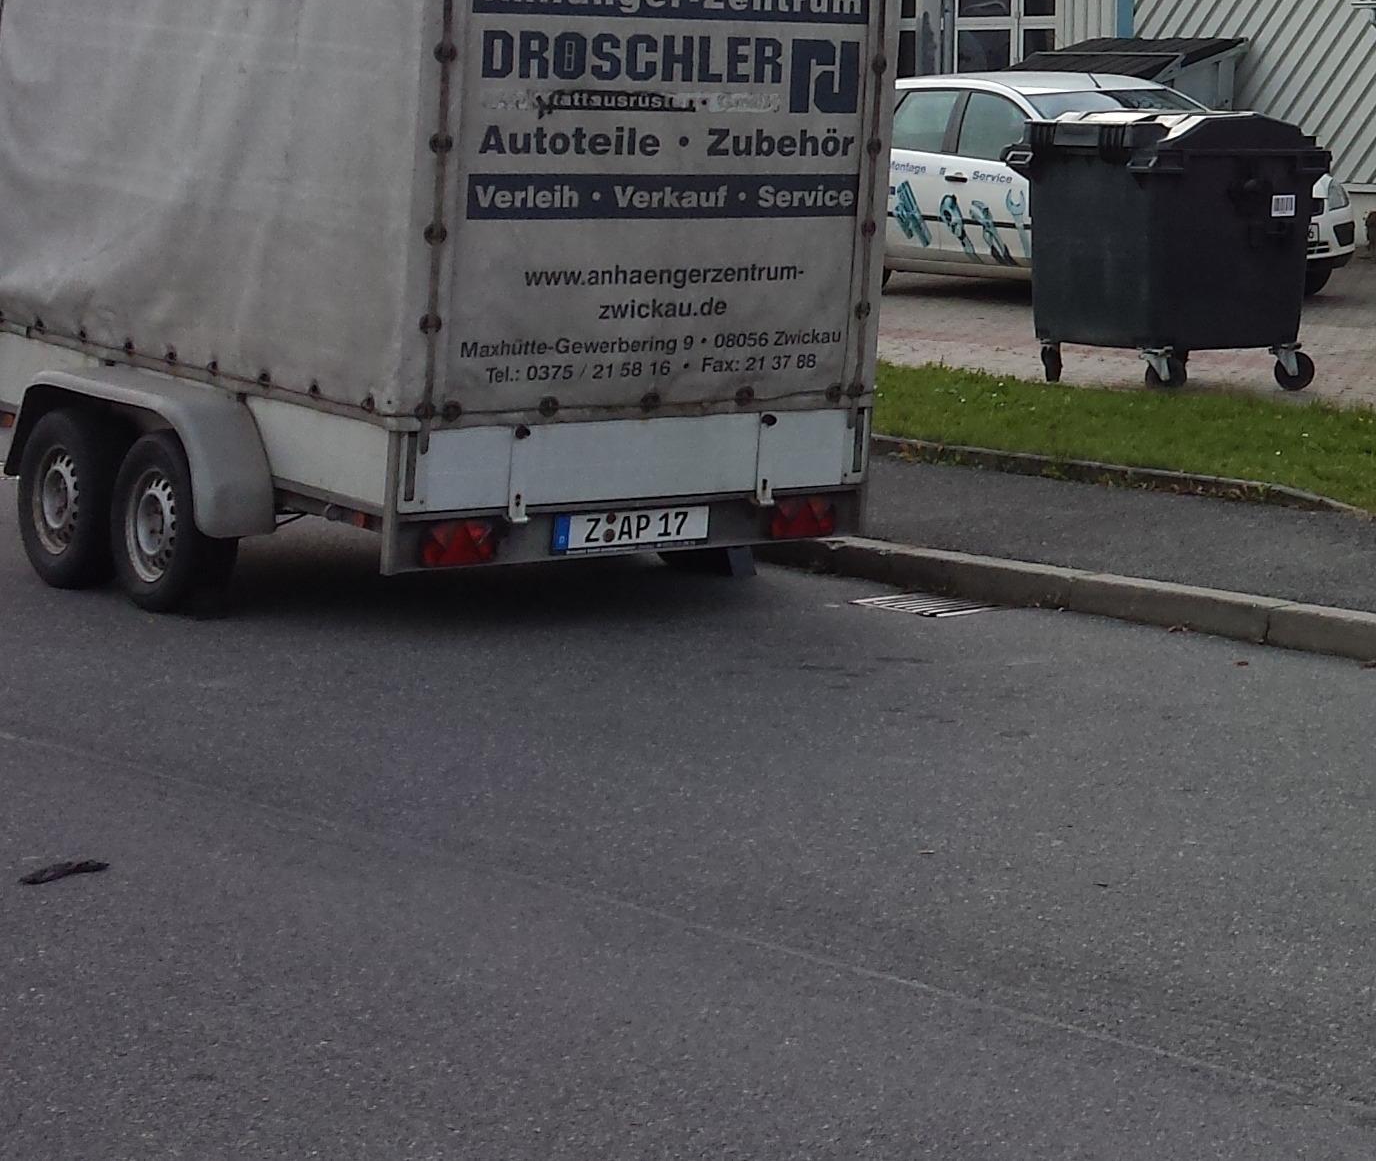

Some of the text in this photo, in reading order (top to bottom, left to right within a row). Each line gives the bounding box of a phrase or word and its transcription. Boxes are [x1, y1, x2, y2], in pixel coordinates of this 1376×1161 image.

[478, 125, 855, 157] Autoteile Zubehör
[972, 170, 1013, 184] Service
[475, 185, 854, 208] Verleih Verkauf Service
[524, 263, 804, 289] www.anhaengerzentrum-
[598, 297, 728, 320] zwickau.de
[460, 329, 842, 359] Maxhütte-Gewerbering 9 08056 Zwickau
[486, 367, 519, 384] Tel.:
[527, 365, 573, 382] 0375
[592, 363, 613, 380] 21
[620, 362, 642, 378] 58
[650, 361, 671, 376] 16
[701, 357, 739, 373] Fax:
[745, 356, 765, 372] 21
[772, 354, 790, 370] 37
[585, 511, 689, 543] Z AP 17
